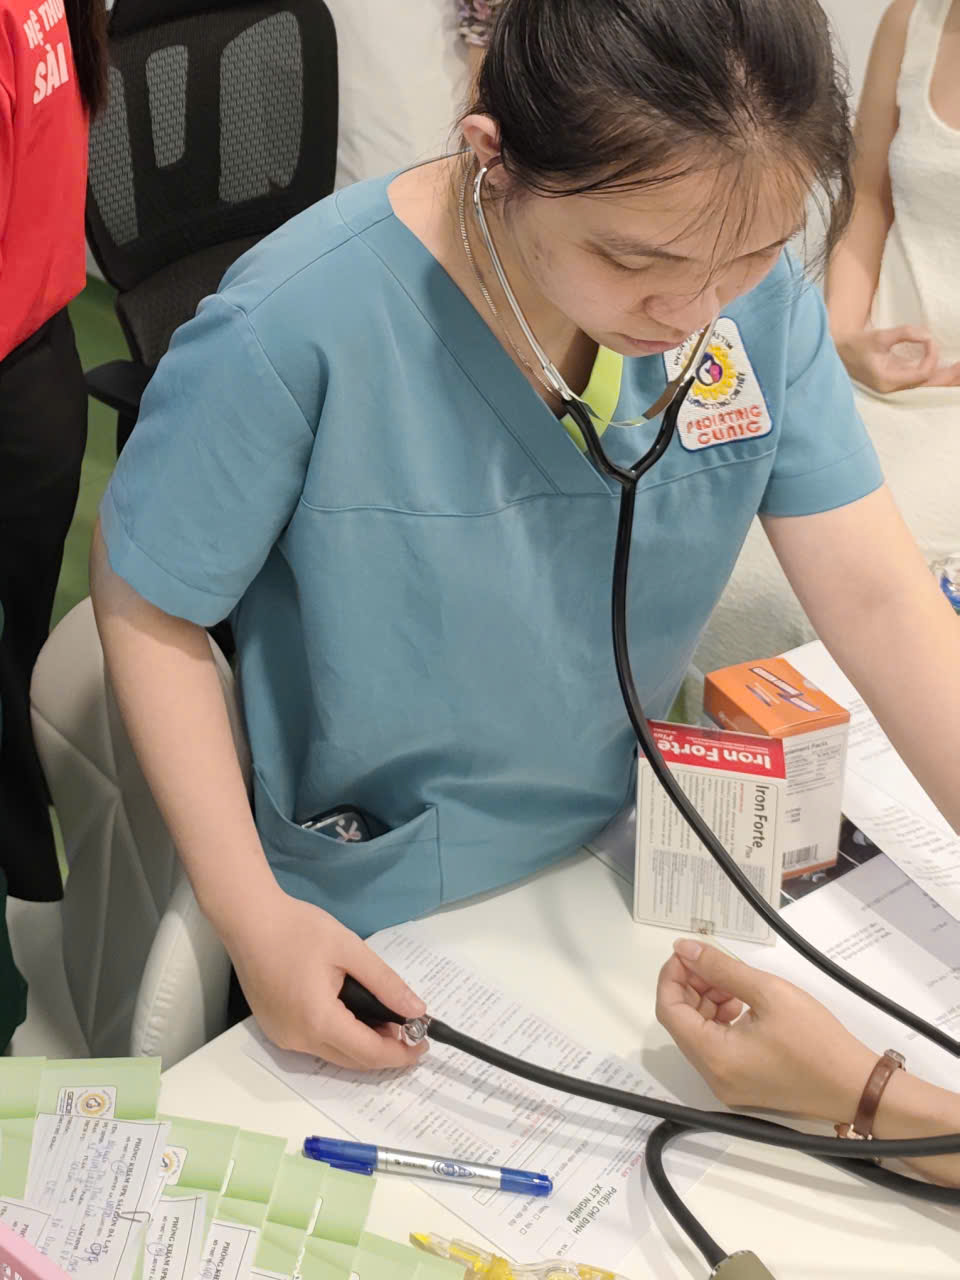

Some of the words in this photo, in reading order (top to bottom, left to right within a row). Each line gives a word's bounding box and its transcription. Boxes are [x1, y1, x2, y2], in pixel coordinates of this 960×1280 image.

[697, 420, 761, 445] CLINIC
[657, 739, 720, 762] Forte
[723, 749, 772, 769] Iron
[754, 784, 770, 811] Iron
[752, 814, 768, 849] Forte
[592, 1184, 603, 1199] XÉT
[597, 1187, 617, 1208] PHIẾU
[566, 1197, 591, 1223] NGHIỆM
[589, 1206, 600, 1221] CHỈ
[572, 1218, 591, 1235] ĐỊNH
